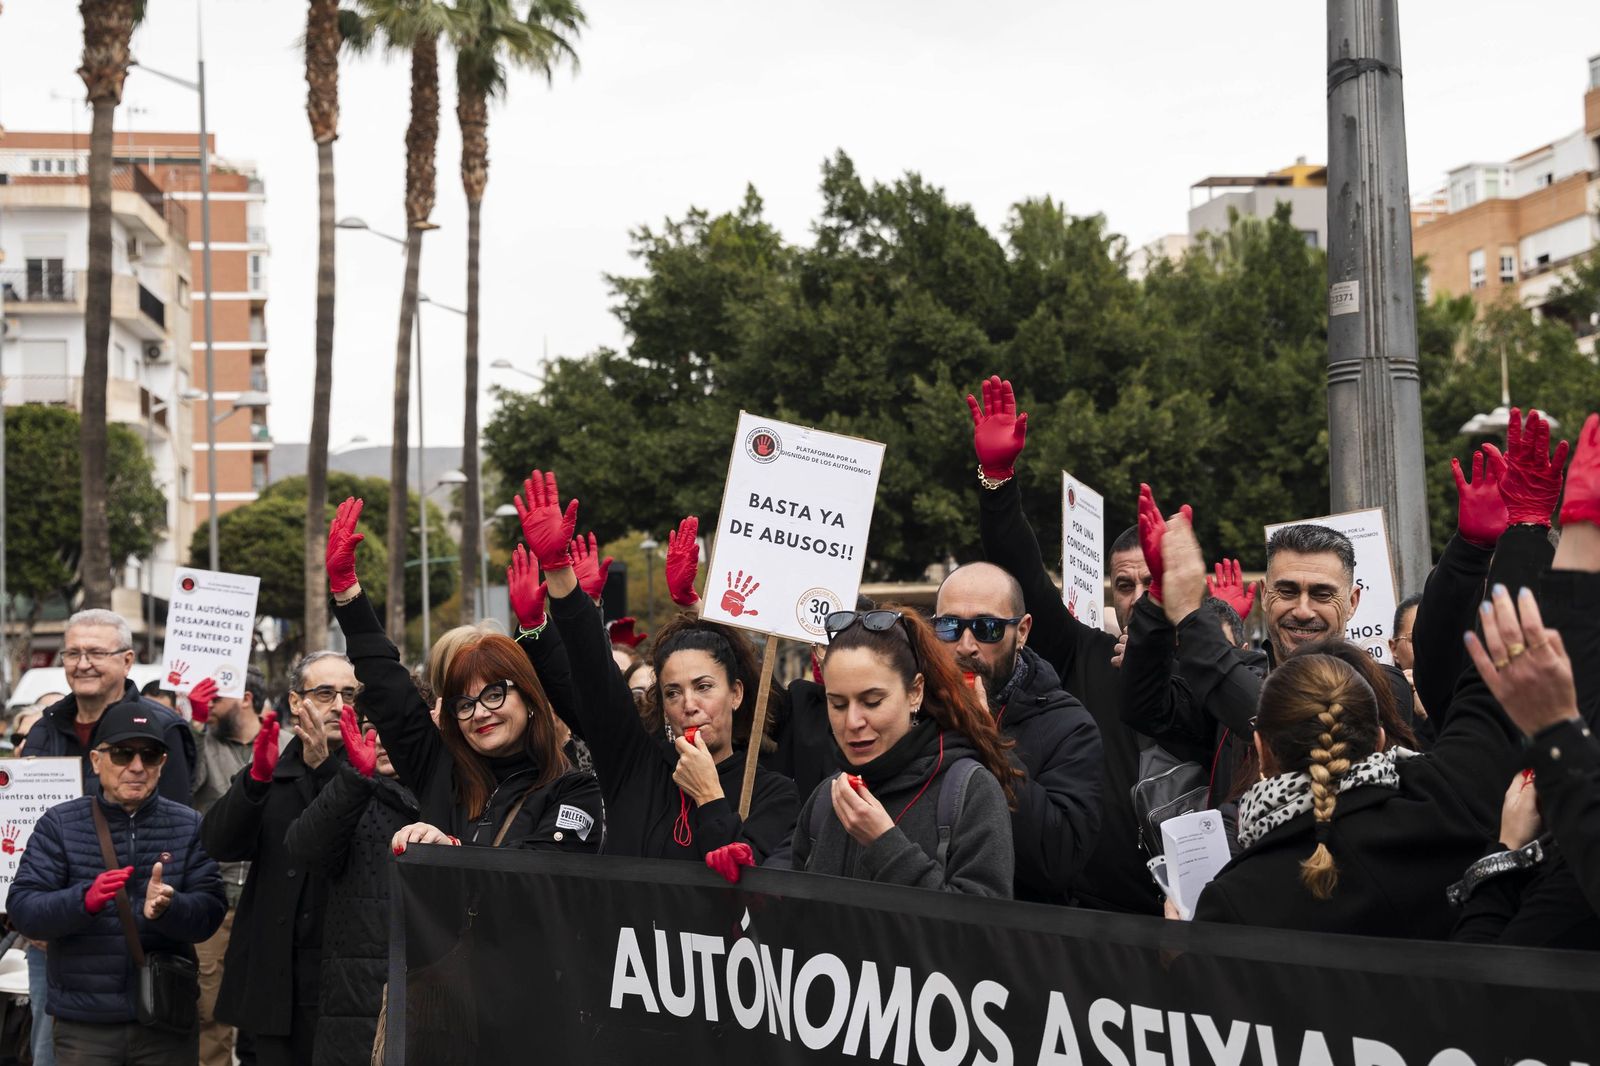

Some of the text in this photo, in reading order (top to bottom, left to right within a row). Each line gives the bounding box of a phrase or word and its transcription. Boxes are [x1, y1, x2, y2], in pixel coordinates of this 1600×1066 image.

[796, 445, 835, 460] PLATAFORMA
[836, 454, 849, 462] POR
[781, 450, 810, 462] DIGNIDAD
[820, 459, 832, 467] LOS
[832, 463, 871, 476] AUTONOMOS
[748, 492, 846, 529] BASTA YA
[729, 519, 854, 561] DE ABUSOS!!
[1072, 520, 1094, 543] POR UNA
[1067, 535, 1100, 563] CONDICIONES
[1070, 555, 1099, 580] DE TRABAJO
[1074, 575, 1093, 594] DIGNAS
[184, 603, 194, 611] EL
[197, 604, 250, 618] AUTÓNOMO
[809, 598, 830, 616] 30
[175, 615, 244, 631] DESAPARECE EL
[195, 631, 231, 643] ENTERO
[233, 636, 243, 644] SE
[180, 643, 232, 657] DESVANECE
[220, 671, 233, 681] 30
[7, 817, 37, 825] vacaci
[609, 906, 1014, 1066] AUTÓNOMOS
